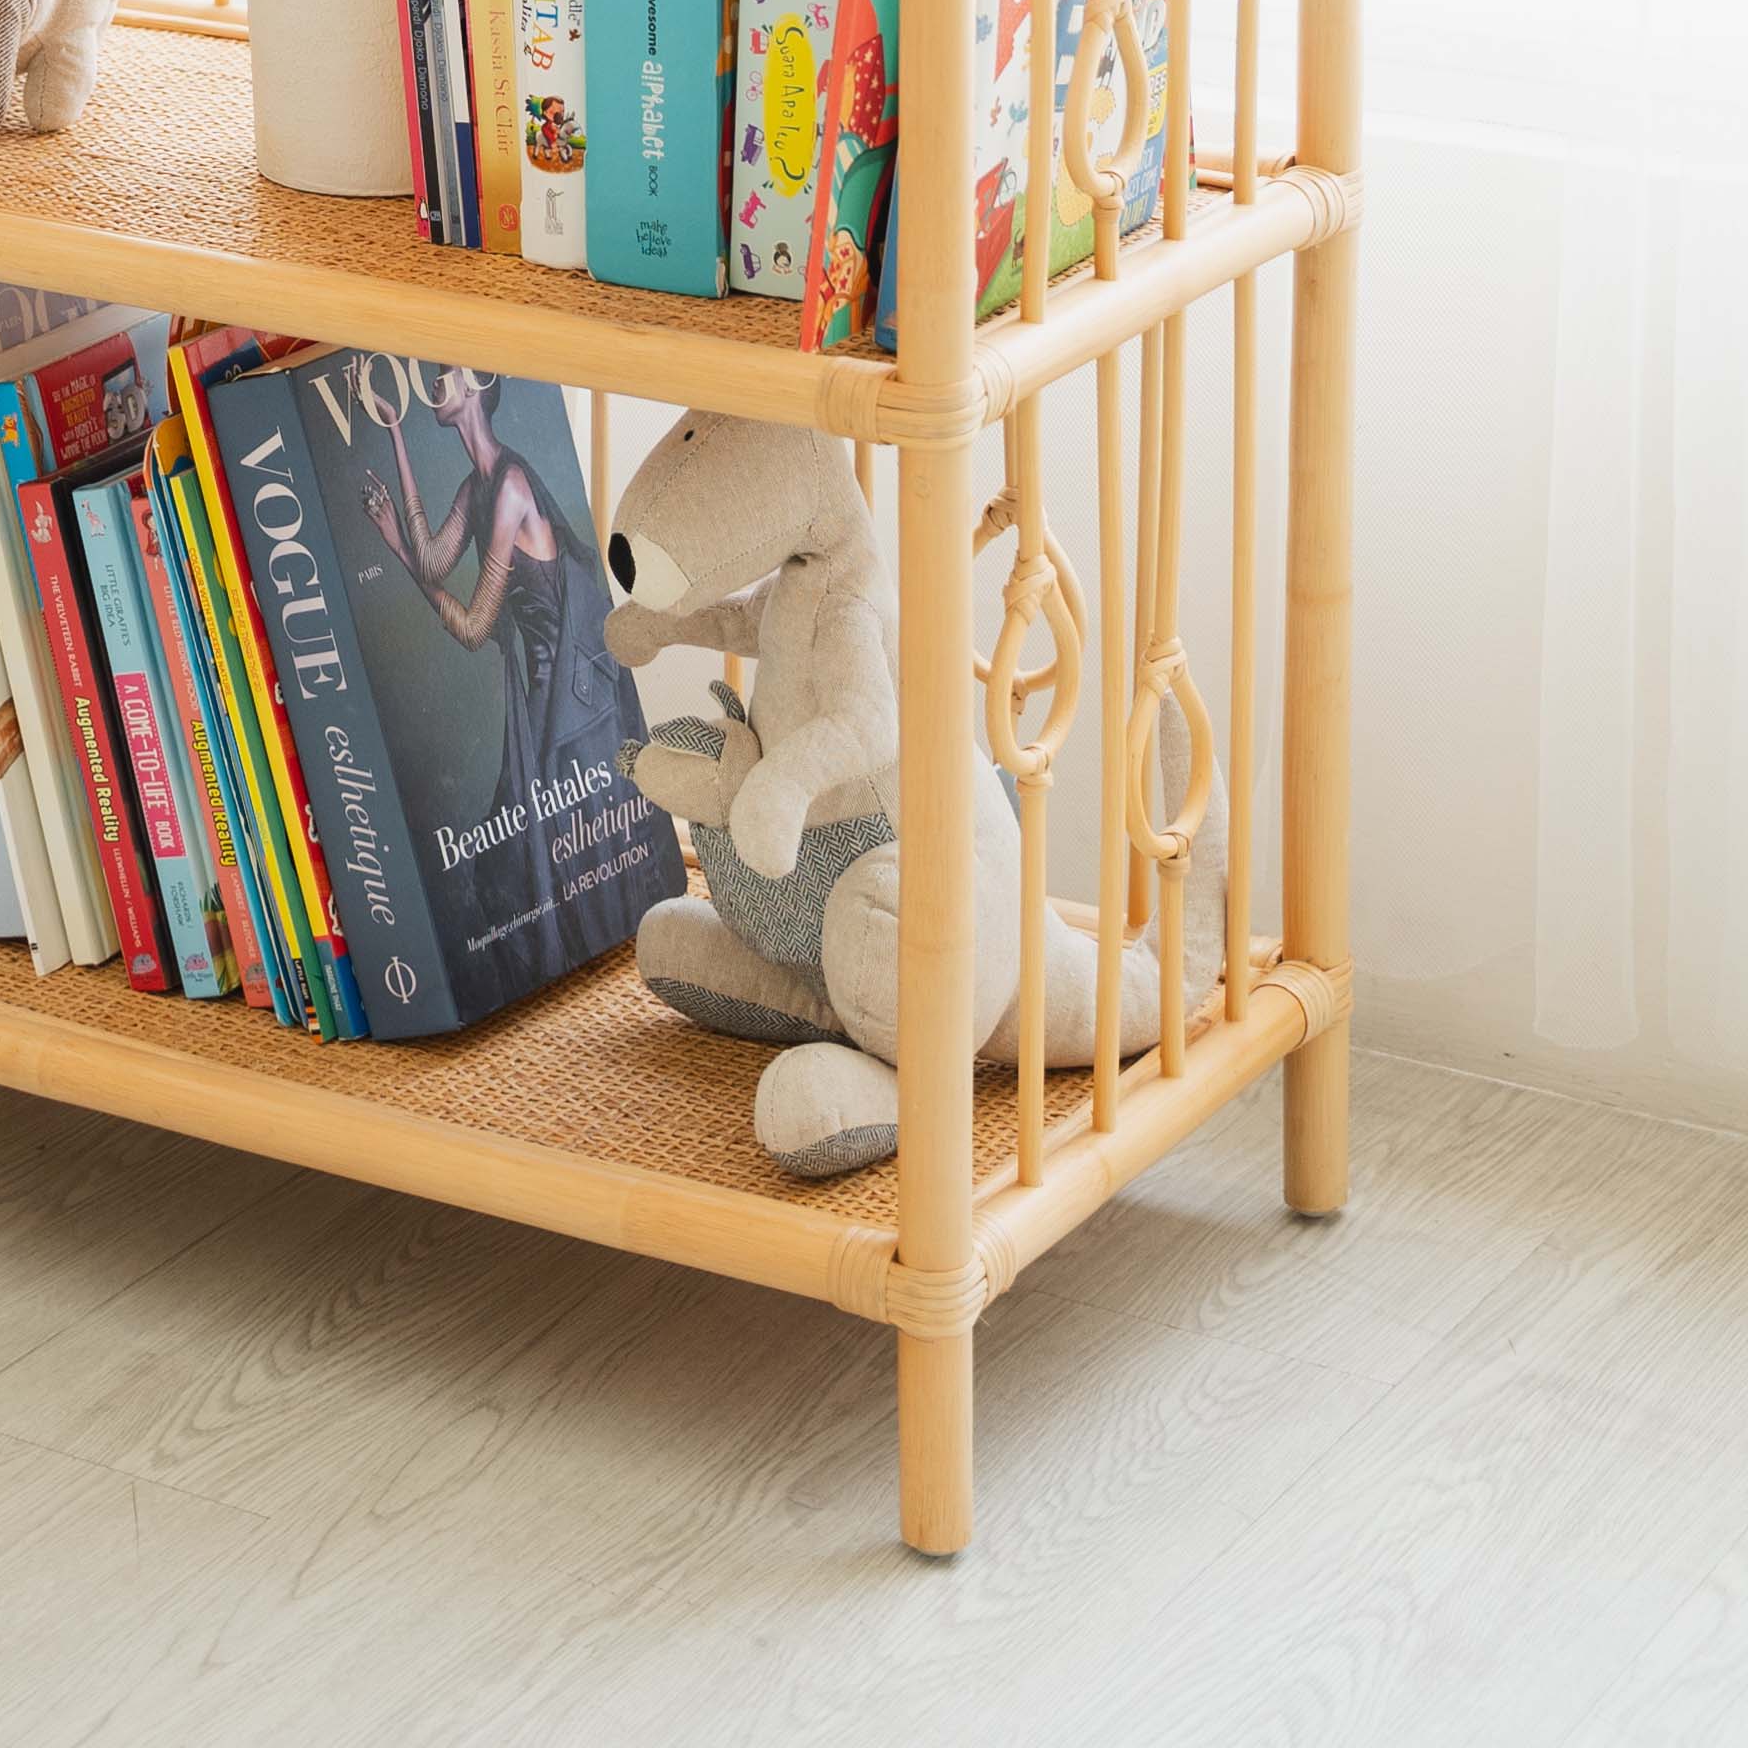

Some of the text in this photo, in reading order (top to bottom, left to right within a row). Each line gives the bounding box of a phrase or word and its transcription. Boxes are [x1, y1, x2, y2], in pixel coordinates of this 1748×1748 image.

[414, 28, 426, 62] Djoko
[433, 22, 444, 55] Djoko
[775, 25, 805, 80] Suara
[417, 66, 429, 111] Damono
[436, 58, 449, 103] Damono
[489, 9, 514, 156] Kassia St Clair
[782, 85, 805, 120] Apa
[640, 59, 666, 163] alphabet
[648, 164, 659, 197] BOOK
[104, 563, 118, 594] LITTLE
[239, 425, 348, 700] VOGUE
[357, 563, 384, 585] PARIS
[100, 584, 116, 629] BIG IDEA
[171, 617, 182, 640] RED
[189, 547, 233, 696] COLOUR WITH STICKERS NATURE
[49, 573, 83, 688] THE VELVETEEN RABBIT
[176, 640, 190, 676] RIDING
[186, 680, 200, 712] HOOD
[74, 695, 121, 843] Augmented Reality
[124, 683, 136, 694] A
[154, 820, 176, 851] BOOK
[190, 718, 238, 867] Augmented Reality
[433, 757, 612, 872] Beaute fatales
[563, 842, 650, 901] LA REVOLUTION
